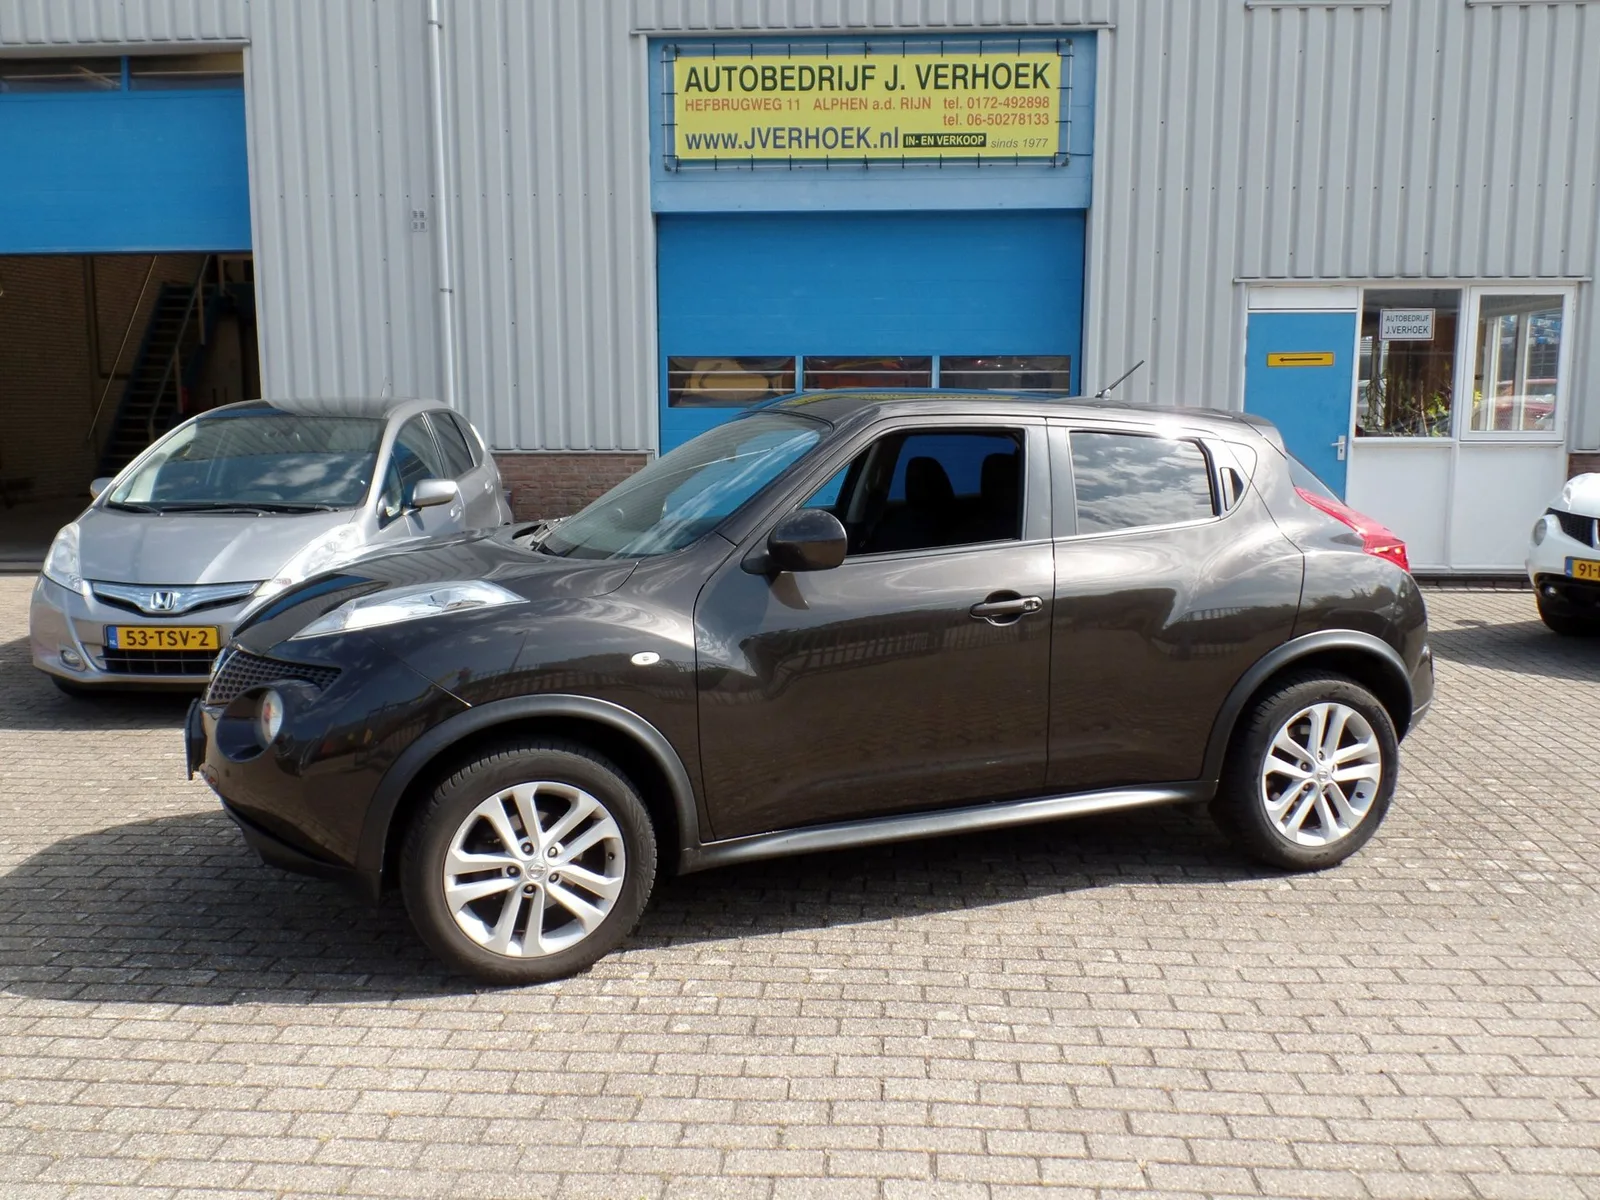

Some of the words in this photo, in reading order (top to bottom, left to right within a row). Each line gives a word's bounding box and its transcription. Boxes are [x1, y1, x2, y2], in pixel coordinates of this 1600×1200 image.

[684, 64, 876, 93] AUTOBEDRIJF
[884, 64, 905, 91] J.
[915, 62, 1051, 90] VERHOEK
[685, 98, 782, 112] HEFBRUGWEG
[787, 99, 800, 111] 11
[813, 97, 868, 111] ALPHEN
[872, 97, 896, 110] a.d.
[900, 97, 931, 110] RIJN
[943, 96, 963, 110] tel.
[967, 96, 1050, 109] 0172-492898
[943, 113, 963, 126] tel.
[966, 112, 1049, 126] 06-50278133
[685, 126, 899, 150] www.JVERHOEK.nl
[905, 135, 919, 146] IN-
[921, 135, 935, 146] EN
[936, 134, 985, 146] VERKOOP
[990, 138, 1018, 148] sinds
[1023, 138, 1048, 148] 1977
[1385, 314, 1430, 322] AUTOBEDRIJF
[1385, 325, 1429, 335] J.VERHOEK
[1578, 563, 1600, 579] 91-
[126, 630, 209, 647] 53-TSV-2
